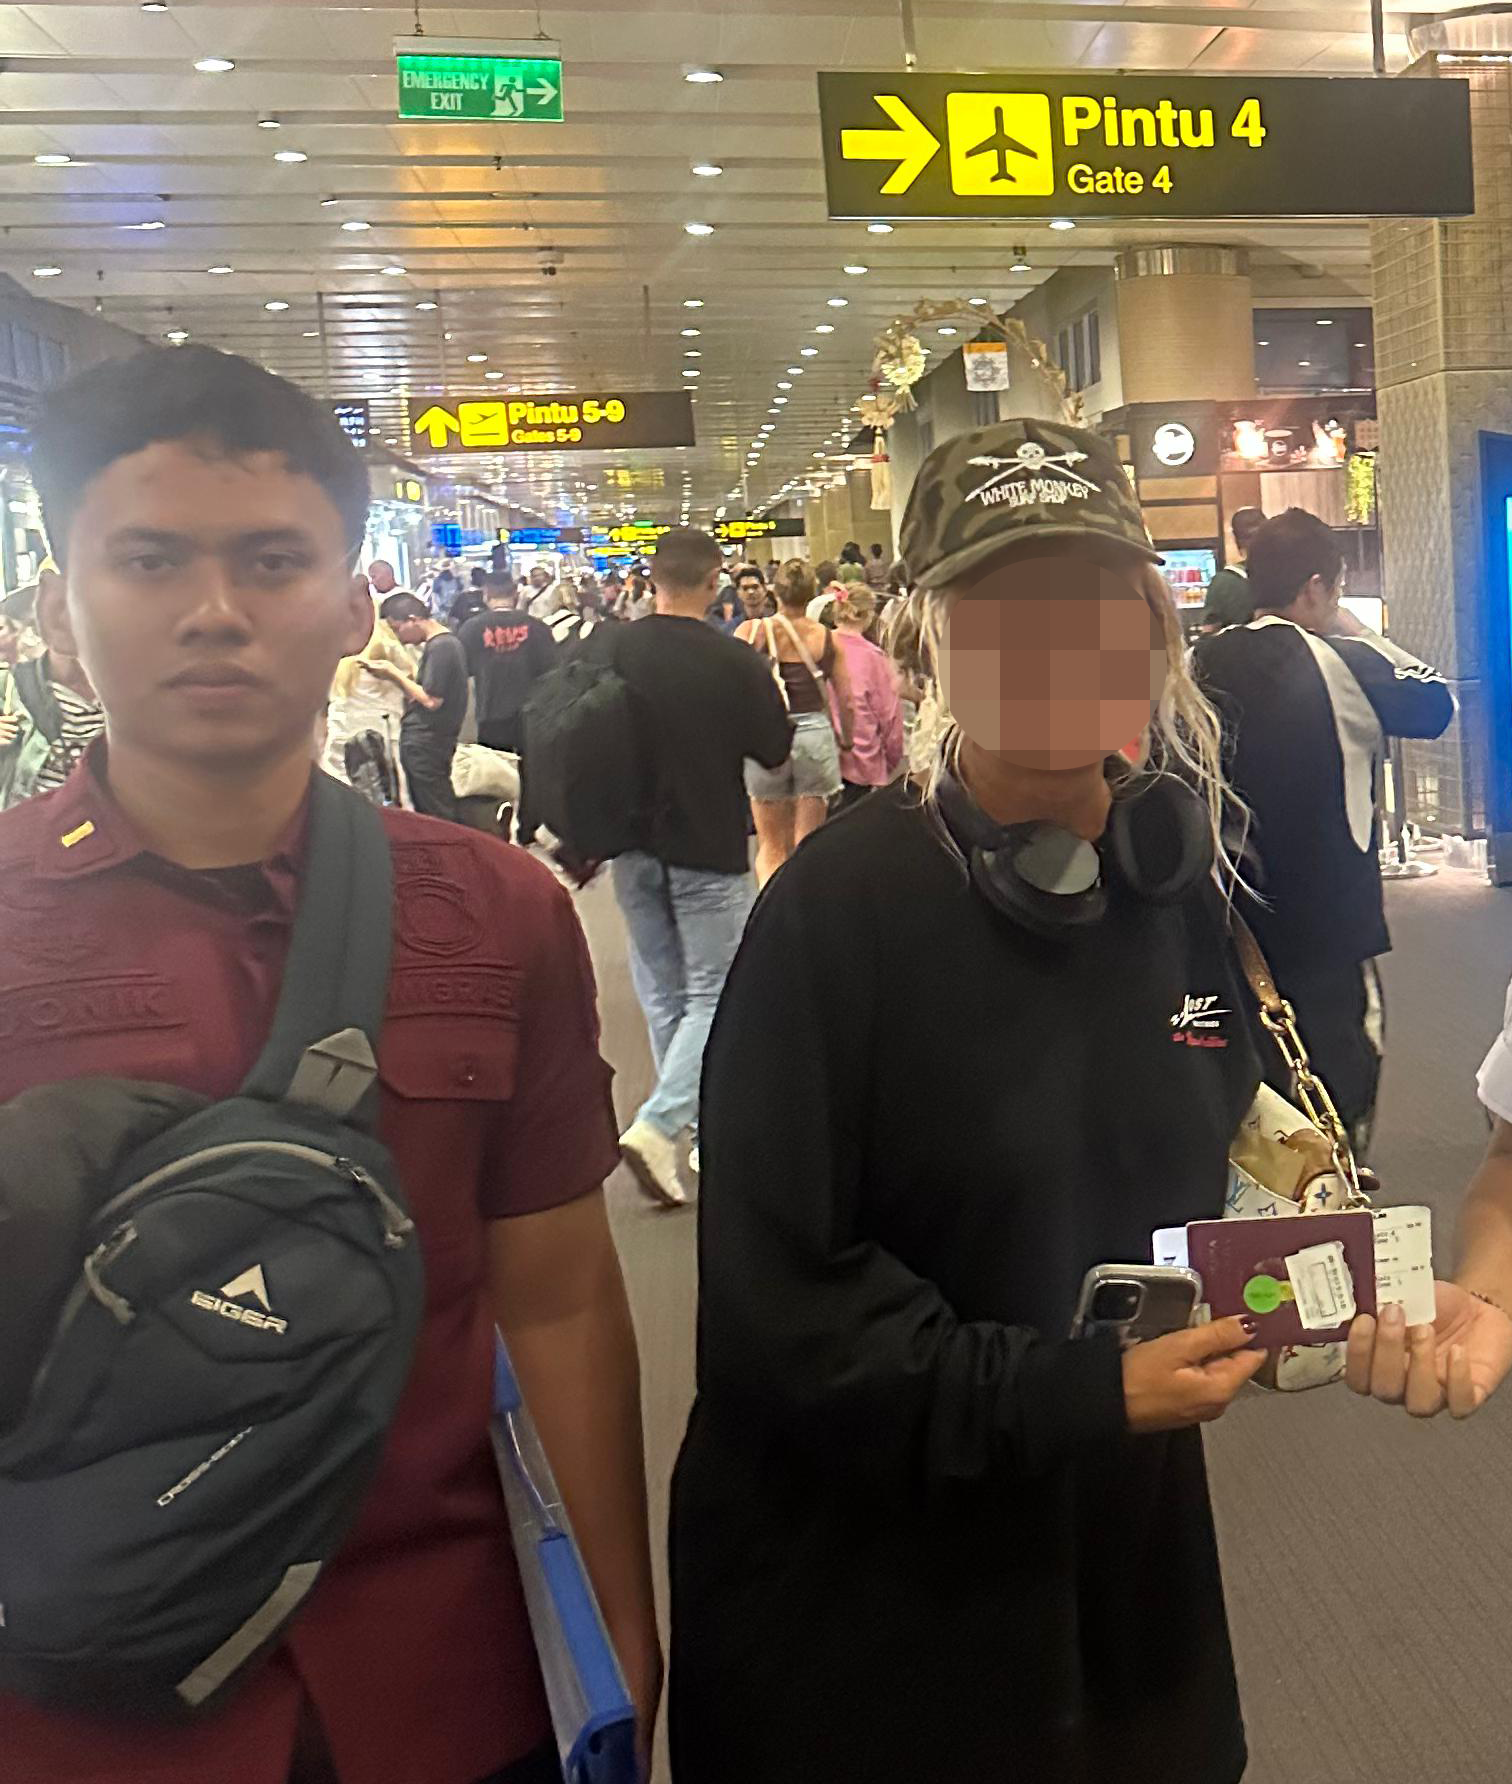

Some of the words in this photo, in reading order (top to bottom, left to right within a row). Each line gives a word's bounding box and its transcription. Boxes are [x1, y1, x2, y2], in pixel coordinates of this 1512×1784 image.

[402, 70, 489, 91] EMERGENCY
[430, 92, 463, 111] EXIT
[1062, 95, 1215, 148] Pintu
[1231, 98, 1267, 148] 4
[1067, 163, 1144, 195] Gate
[1151, 165, 1174, 194] 4
[508, 401, 579, 425] Pintu
[582, 399, 626, 424] 5-9
[511, 429, 556, 444] Gates
[556, 427, 582, 443] 5-9
[980, 480, 1027, 506] WHITE
[1030, 478, 1089, 500] MONKEY
[190, 1290, 289, 1335] EIGER
